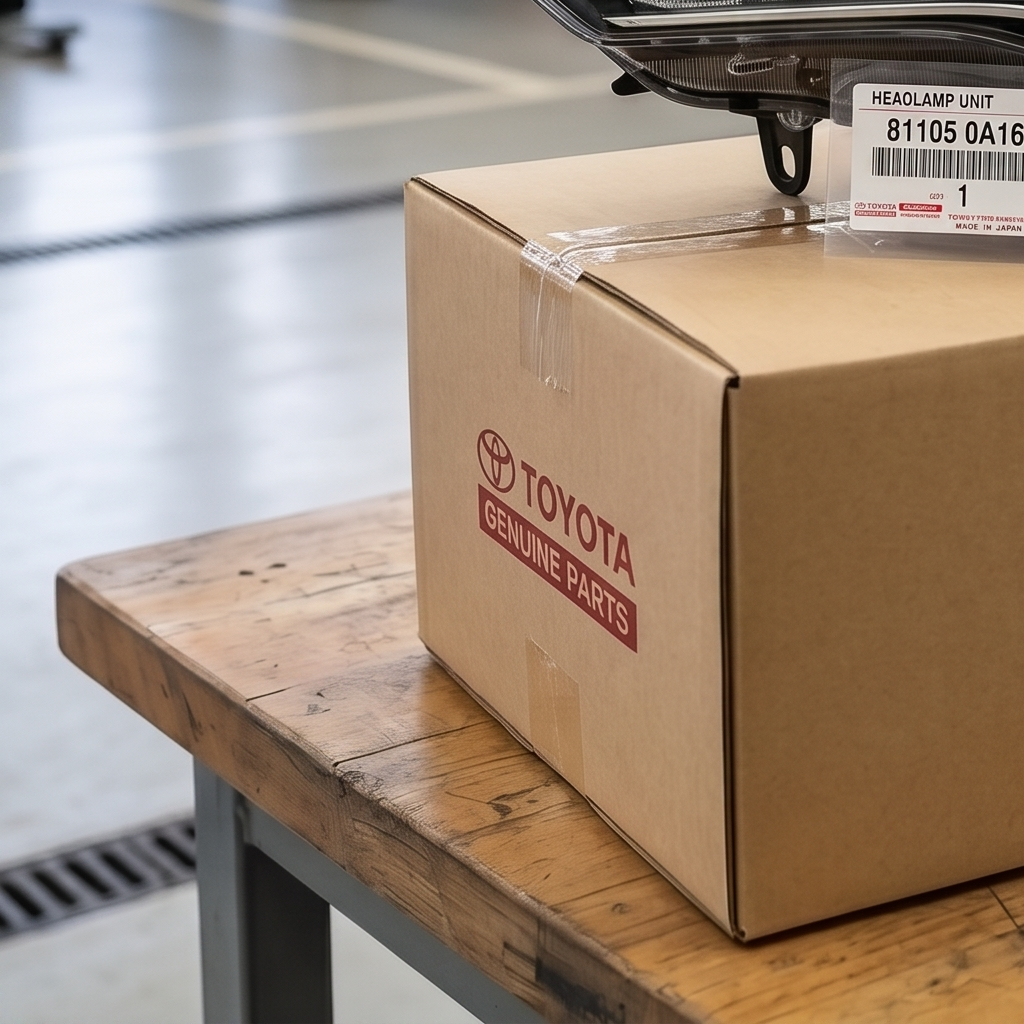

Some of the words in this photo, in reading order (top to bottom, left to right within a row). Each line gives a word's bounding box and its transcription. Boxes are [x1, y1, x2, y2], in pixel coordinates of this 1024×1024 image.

[959, 94, 994, 109] UNIT
[887, 118, 957, 144] 81105
[958, 184, 967, 207] 1
[521, 459, 636, 588] TOYOTA
[484, 499, 561, 582] GENUINE
[566, 560, 629, 636] PARTS
